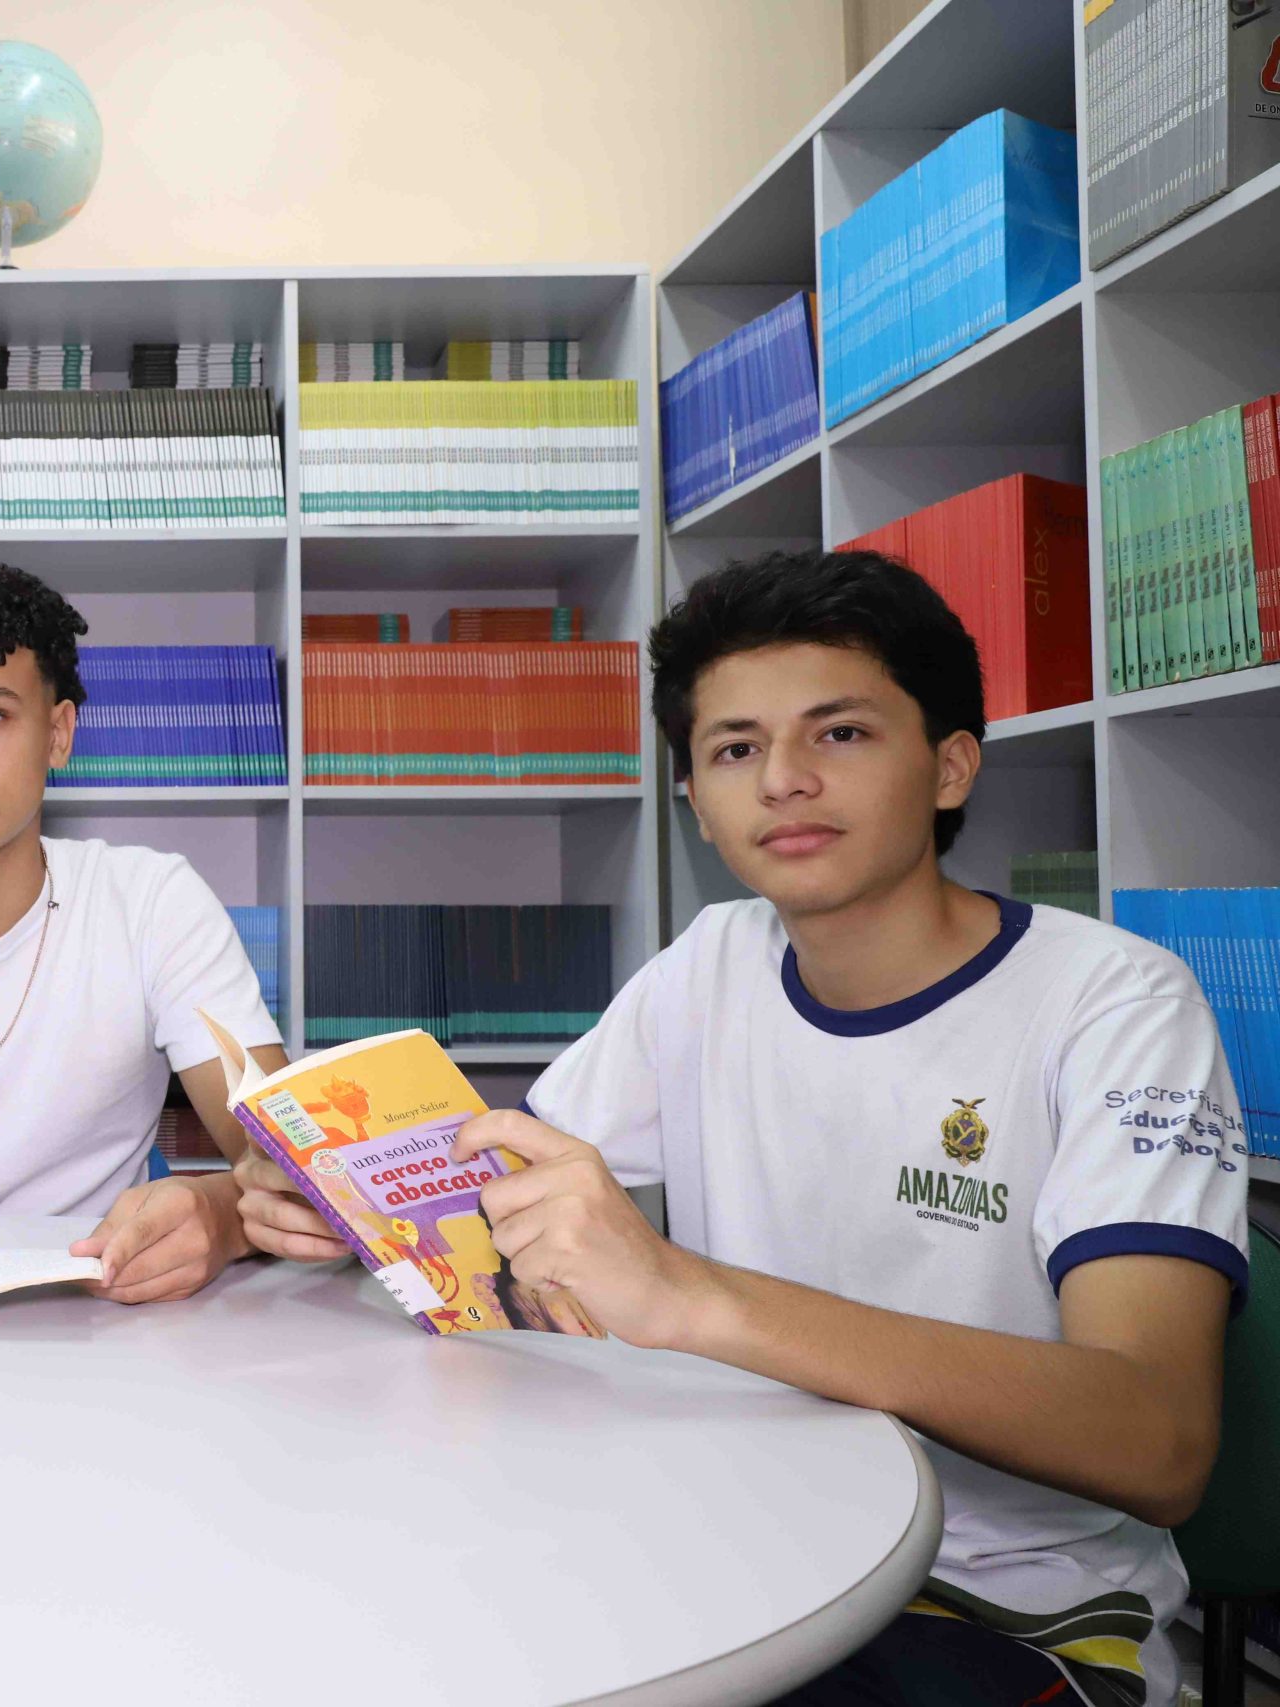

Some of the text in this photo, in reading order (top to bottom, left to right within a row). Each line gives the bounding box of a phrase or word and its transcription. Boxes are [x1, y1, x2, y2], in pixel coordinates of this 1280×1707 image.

[1255, 104, 1266, 113] DE
[274, 1104, 297, 1118] FNDE
[384, 1100, 450, 1124] Moacyr Scliar
[1105, 1086, 1224, 1117] Secretaria
[352, 1154, 382, 1170] um
[384, 1136, 438, 1160] sonho
[370, 1156, 448, 1186] caroço
[385, 1170, 493, 1206] abacate
[896, 1166, 1008, 1224] AMAZONAS
[916, 1210, 952, 1224] GOVERNO
[957, 1218, 980, 1232] ESTADO
